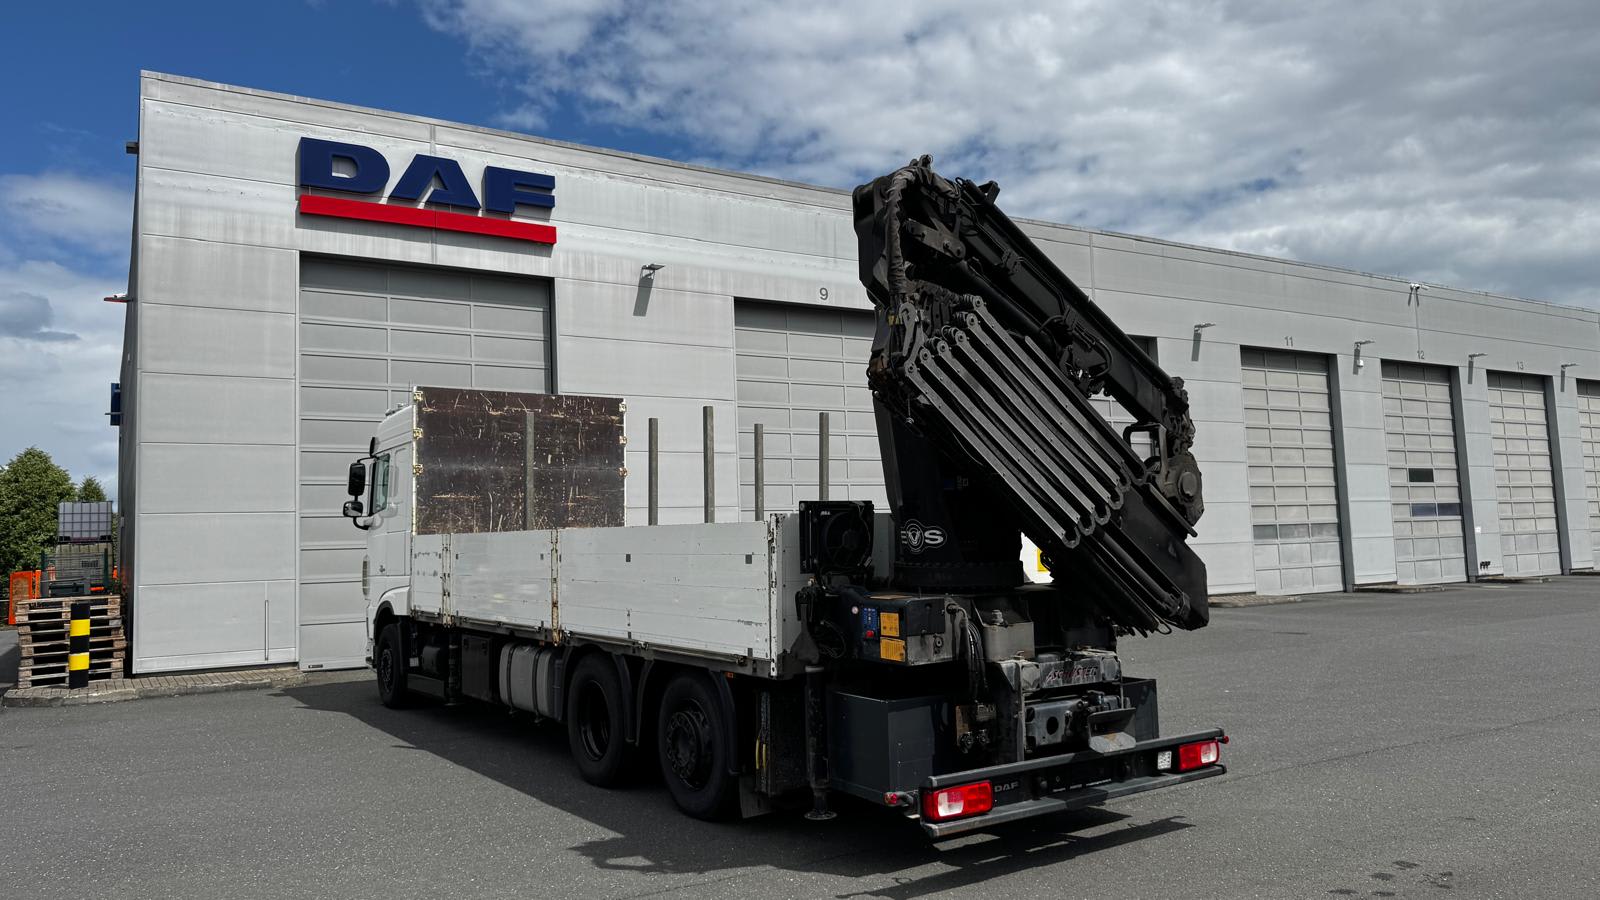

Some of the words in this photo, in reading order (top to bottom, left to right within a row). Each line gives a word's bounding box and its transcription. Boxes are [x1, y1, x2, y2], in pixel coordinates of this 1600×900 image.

[297, 137, 555, 213] DAF
[819, 287, 829, 301] 9
[1284, 335, 1294, 347] 11
[1416, 350, 1425, 360] 12
[1516, 361, 1524, 371] 13
[993, 780, 1020, 793] DAF
